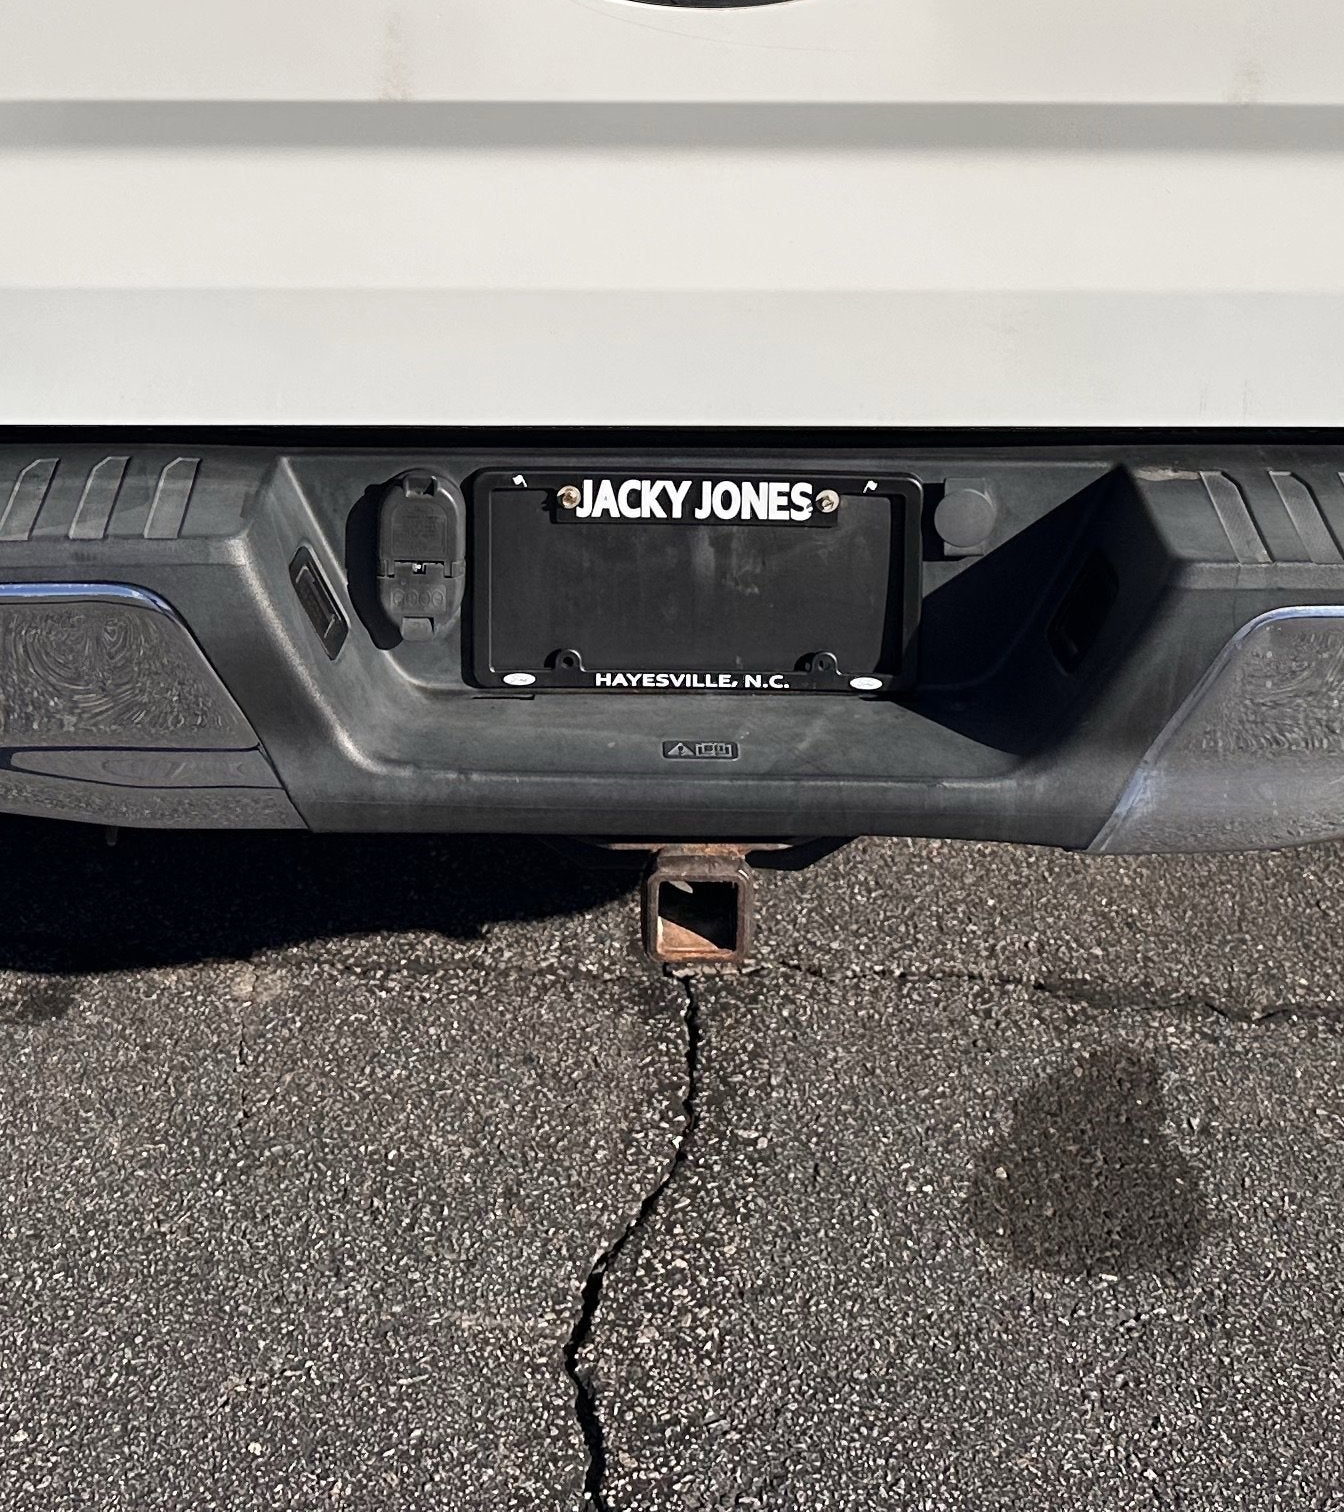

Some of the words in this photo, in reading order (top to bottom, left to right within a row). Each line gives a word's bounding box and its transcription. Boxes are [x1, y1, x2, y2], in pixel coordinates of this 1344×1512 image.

[575, 479, 693, 519] JACKY
[694, 480, 814, 522] JONES
[594, 672, 739, 688] HAYESVILLE,
[744, 674, 790, 689] N.C.
